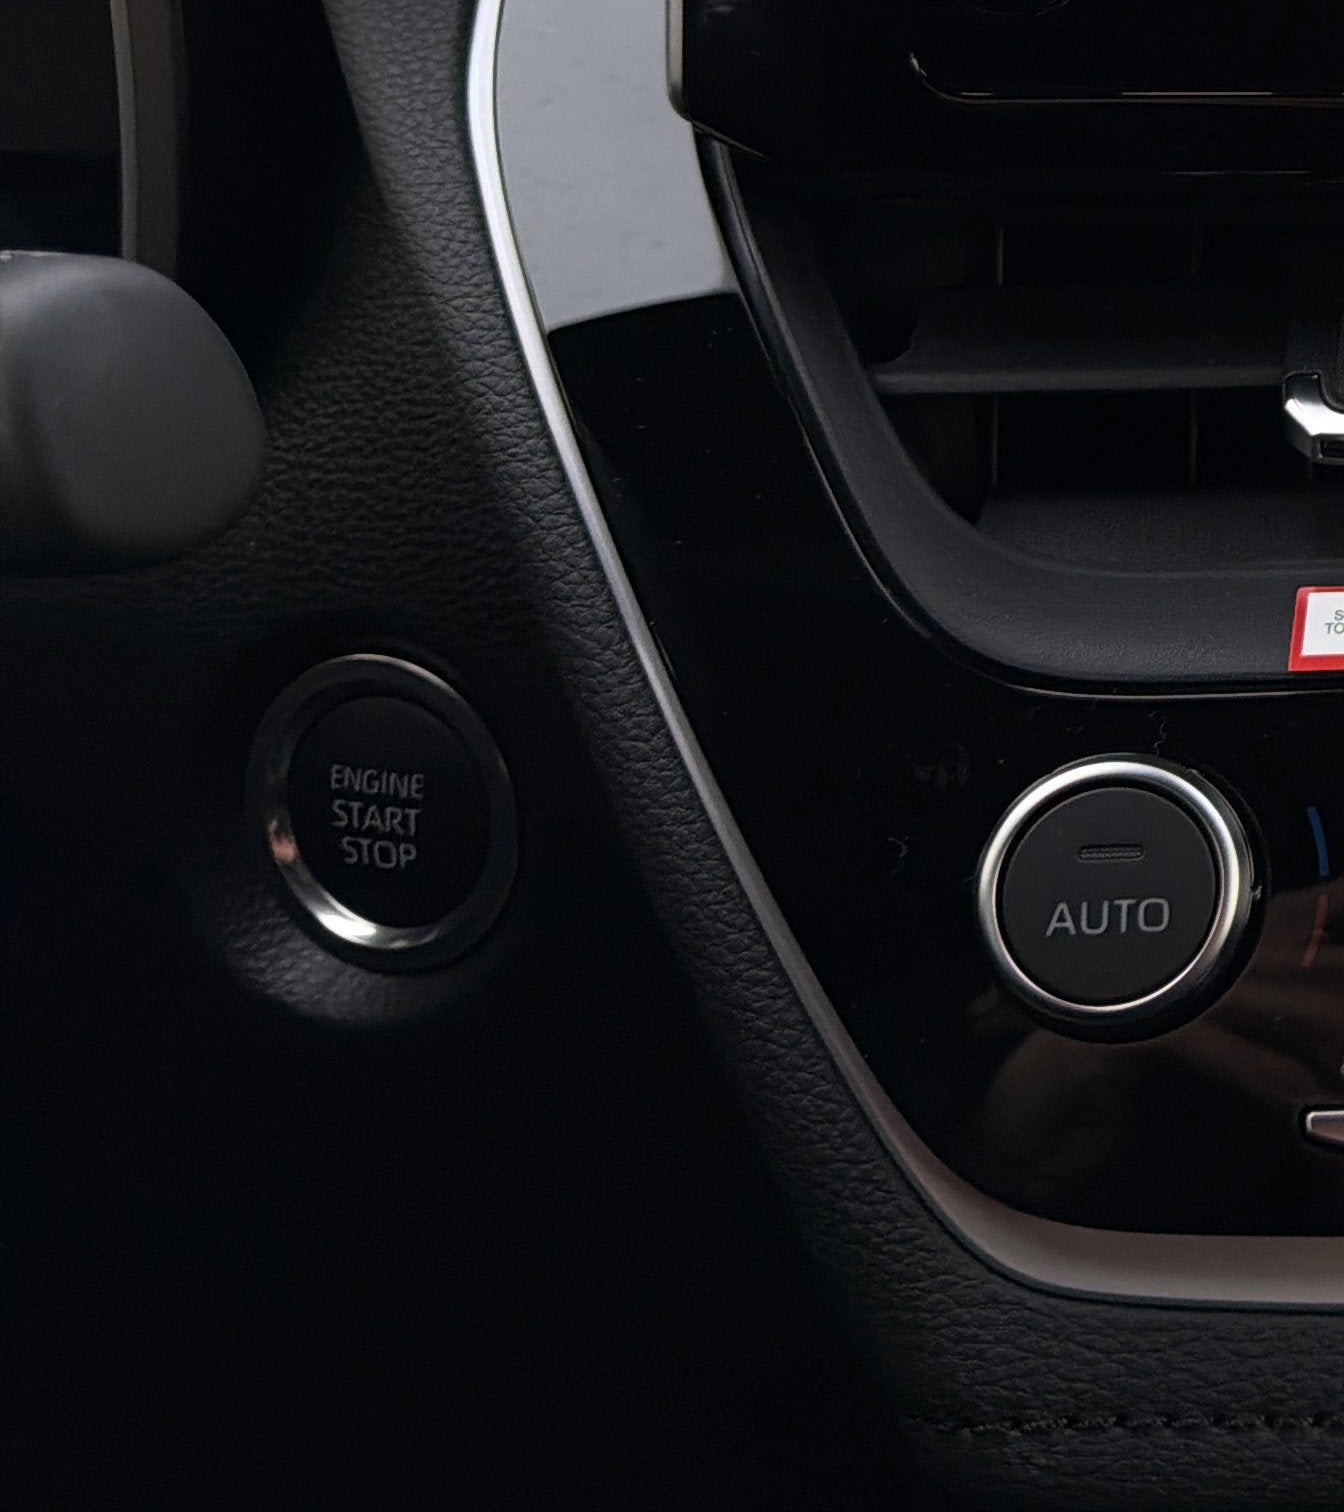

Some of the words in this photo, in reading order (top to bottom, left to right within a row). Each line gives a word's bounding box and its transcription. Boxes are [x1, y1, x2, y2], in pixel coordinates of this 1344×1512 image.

[329, 764, 424, 800] ENGINE
[331, 799, 421, 837] START
[341, 836, 417, 869] STOP
[1045, 896, 1171, 938] AUTO
